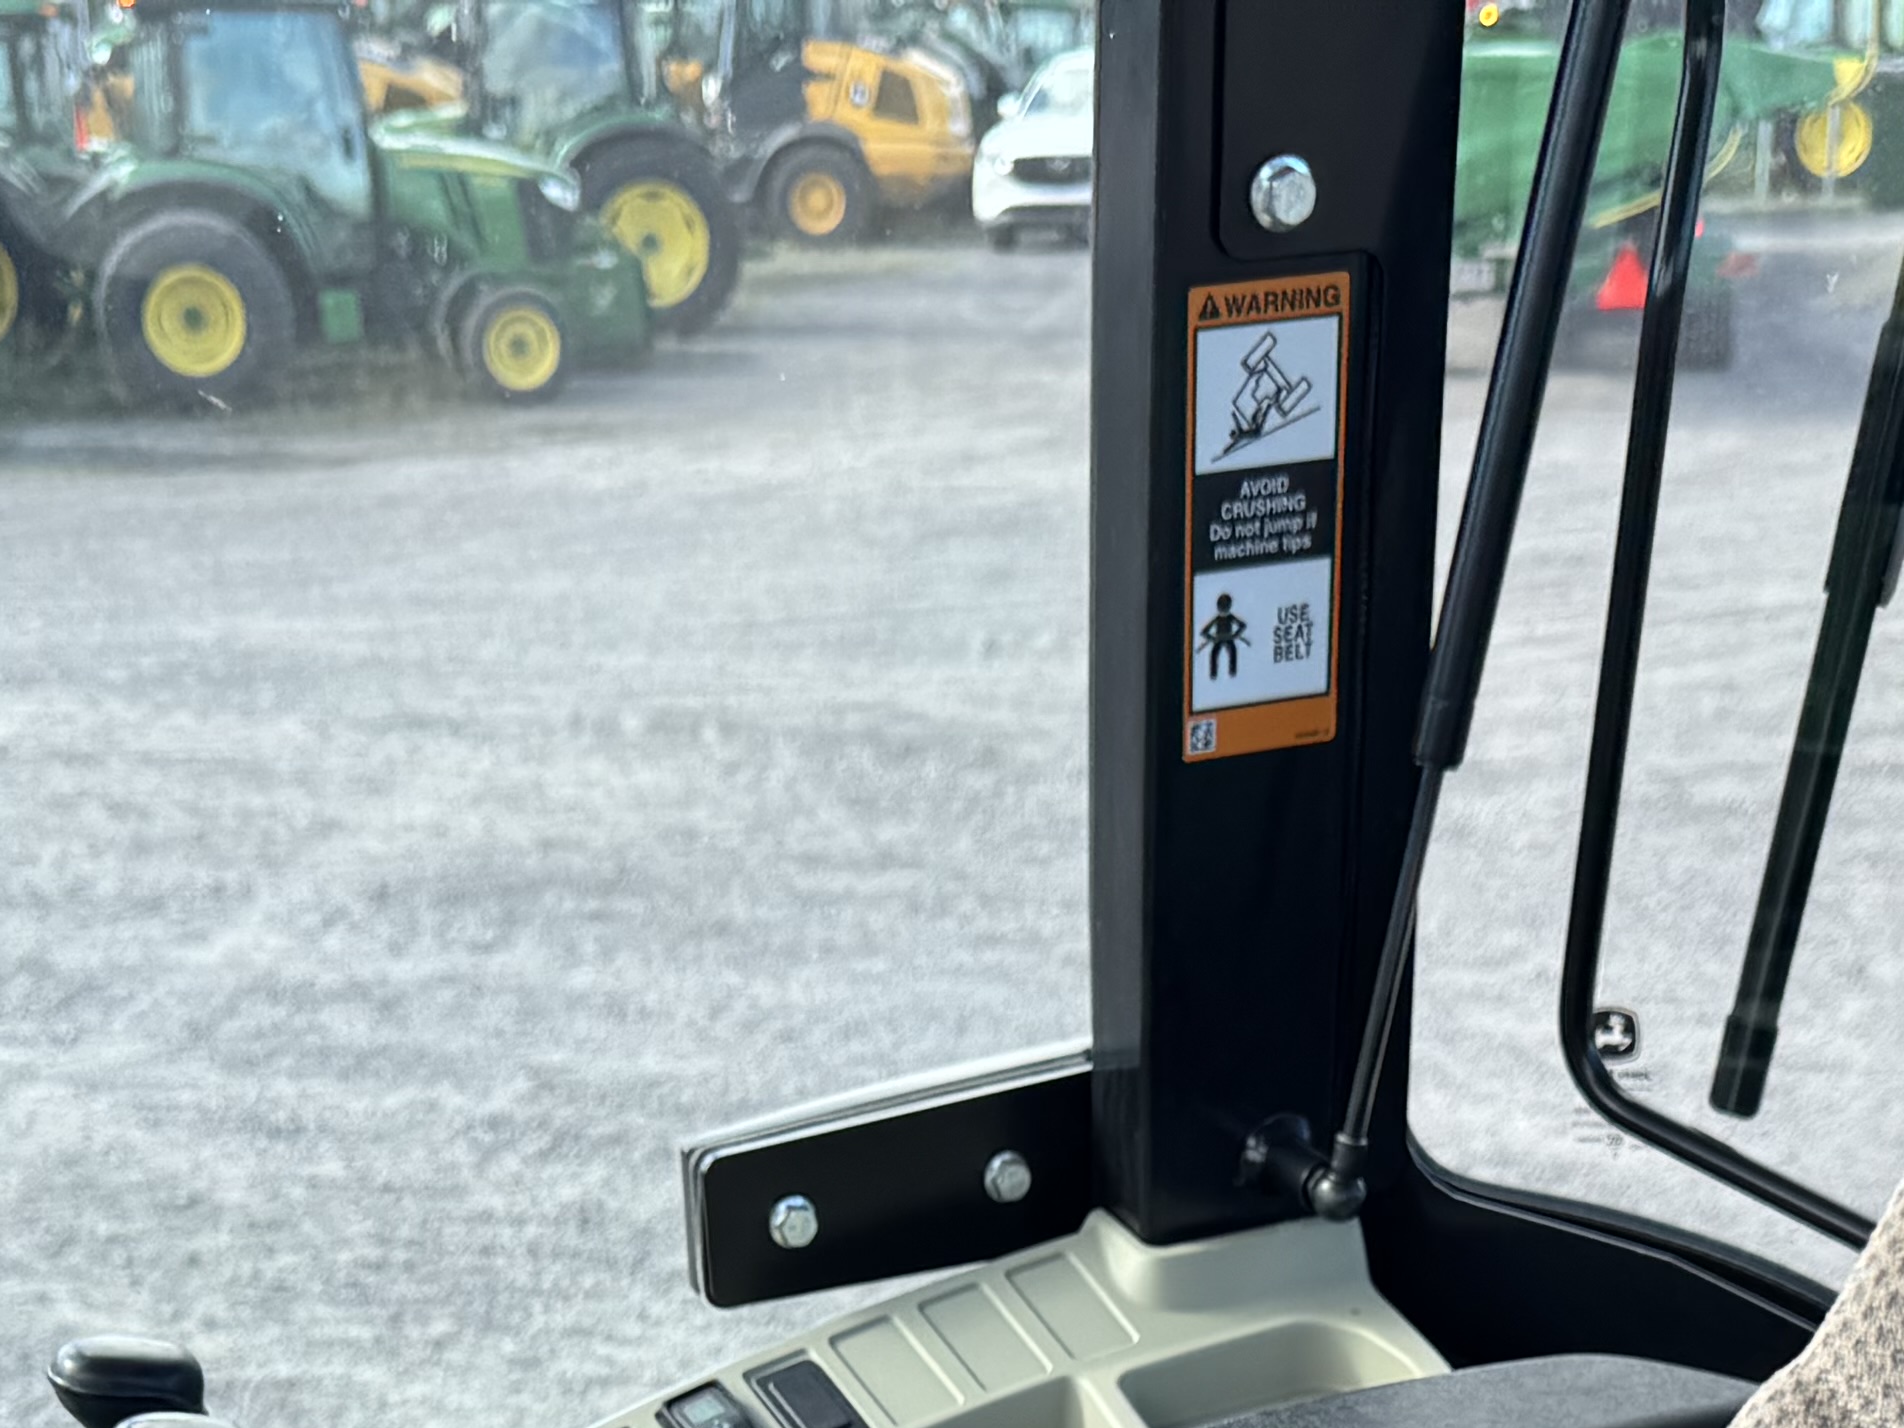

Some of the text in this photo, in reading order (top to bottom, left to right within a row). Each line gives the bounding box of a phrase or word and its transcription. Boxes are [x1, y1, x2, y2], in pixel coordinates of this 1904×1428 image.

[1224, 284, 1341, 318] WARNING
[1239, 476, 1290, 499] AVOID
[1221, 494, 1306, 520] CRUSHING
[1209, 511, 1318, 542] Do not jump if
[1214, 533, 1312, 560] machine tips
[1277, 603, 1309, 625] USE
[1273, 621, 1313, 644] SEAT
[1273, 643, 1312, 663] BELT
